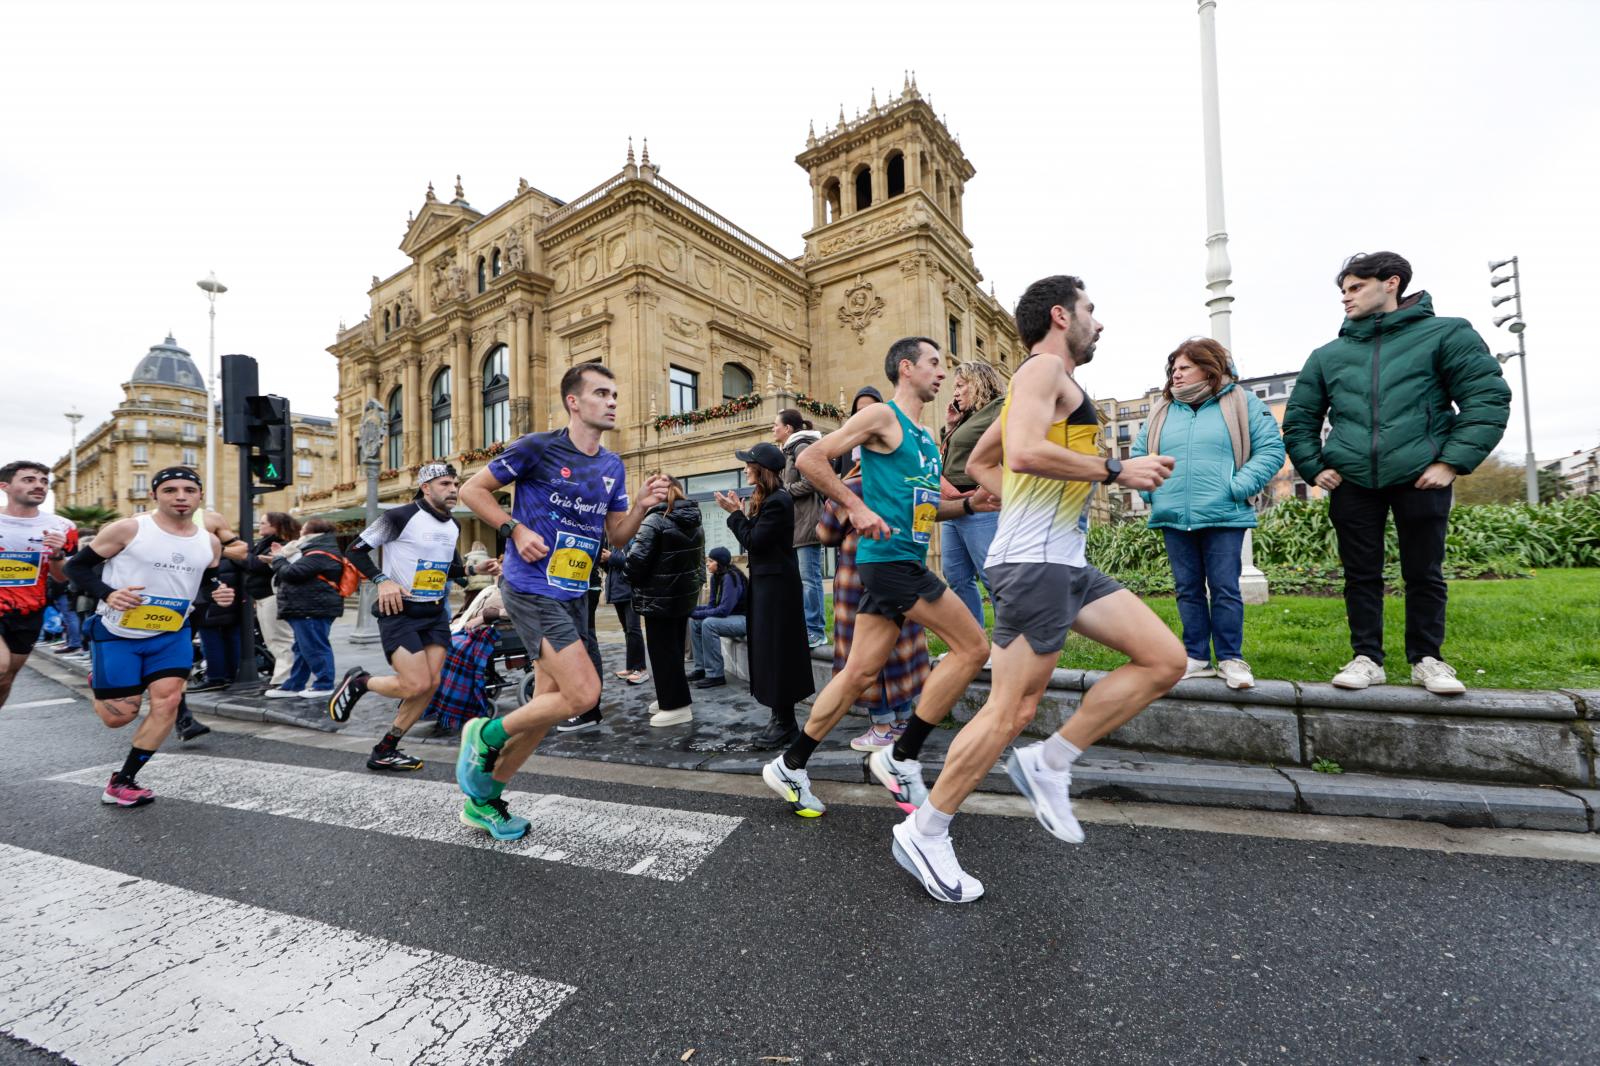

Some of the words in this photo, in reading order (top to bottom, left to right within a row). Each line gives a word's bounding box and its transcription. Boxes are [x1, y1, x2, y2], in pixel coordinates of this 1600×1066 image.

[574, 497, 597, 515] Sport
[154, 599, 183, 607] ZURICH
[143, 613, 173, 622] JOSU
